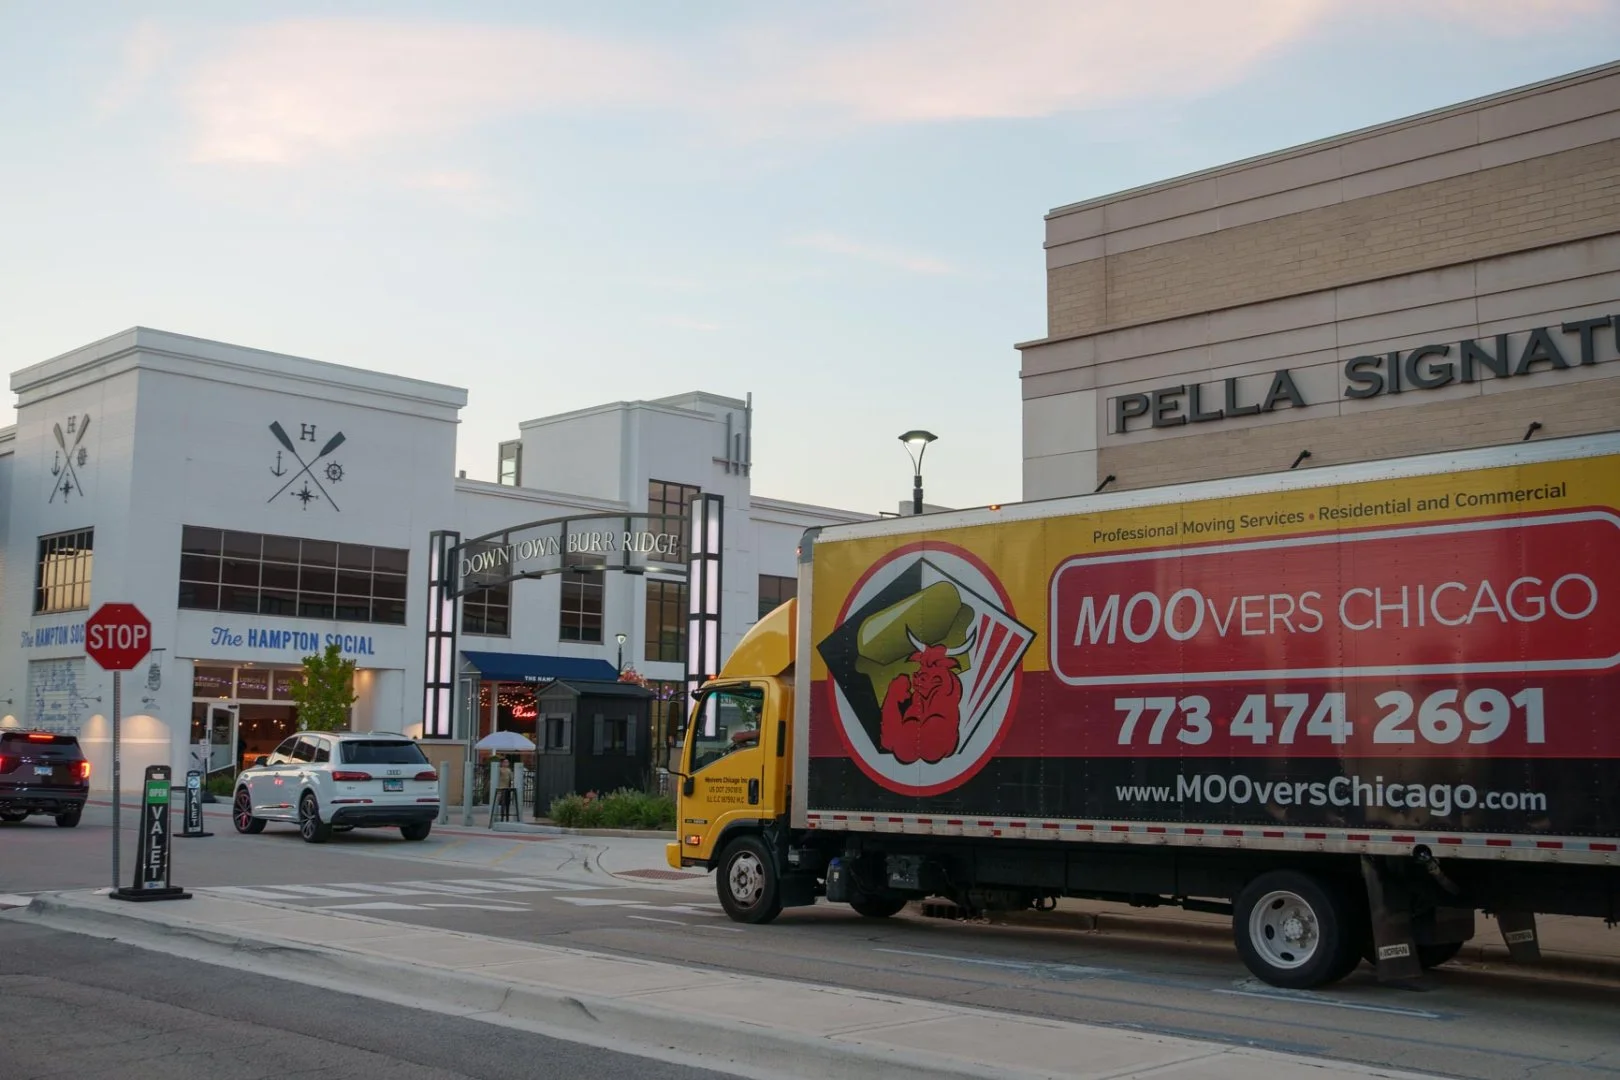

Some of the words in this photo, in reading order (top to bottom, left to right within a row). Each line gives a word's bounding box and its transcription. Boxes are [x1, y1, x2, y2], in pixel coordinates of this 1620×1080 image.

[1115, 369, 1307, 433] PELLA
[1344, 315, 1620, 400] SIGNAT
[67, 415, 77, 434] H
[300, 423, 316, 442] H
[1093, 521, 1179, 544] Professional
[1183, 515, 1236, 538] Moving
[1240, 509, 1305, 529] Services
[1318, 497, 1411, 521] Residential
[1417, 492, 1450, 512] and
[1455, 481, 1567, 508] Commercial
[459, 535, 563, 577] DOWNTOWN
[568, 531, 615, 553] BURR
[621, 531, 680, 556] RIDGE
[1074, 588, 1323, 647] MOOVERS
[1338, 573, 1598, 632] CHICAGO
[21, 631, 34, 648] The
[35, 625, 68, 647] HAMPTON
[89, 624, 148, 650] STOP
[211, 626, 244, 647] The
[248, 628, 319, 651] HAMPTON
[325, 633, 375, 655] SOCIAL
[1114, 694, 1213, 746] 773
[1230, 692, 1353, 745] 474
[1373, 687, 1546, 745] 2691
[149, 788, 167, 798] OPEN
[190, 789, 198, 826] VALET
[1115, 774, 1547, 817] www.MOOversChicago.com
[150, 806, 163, 879] VALET
